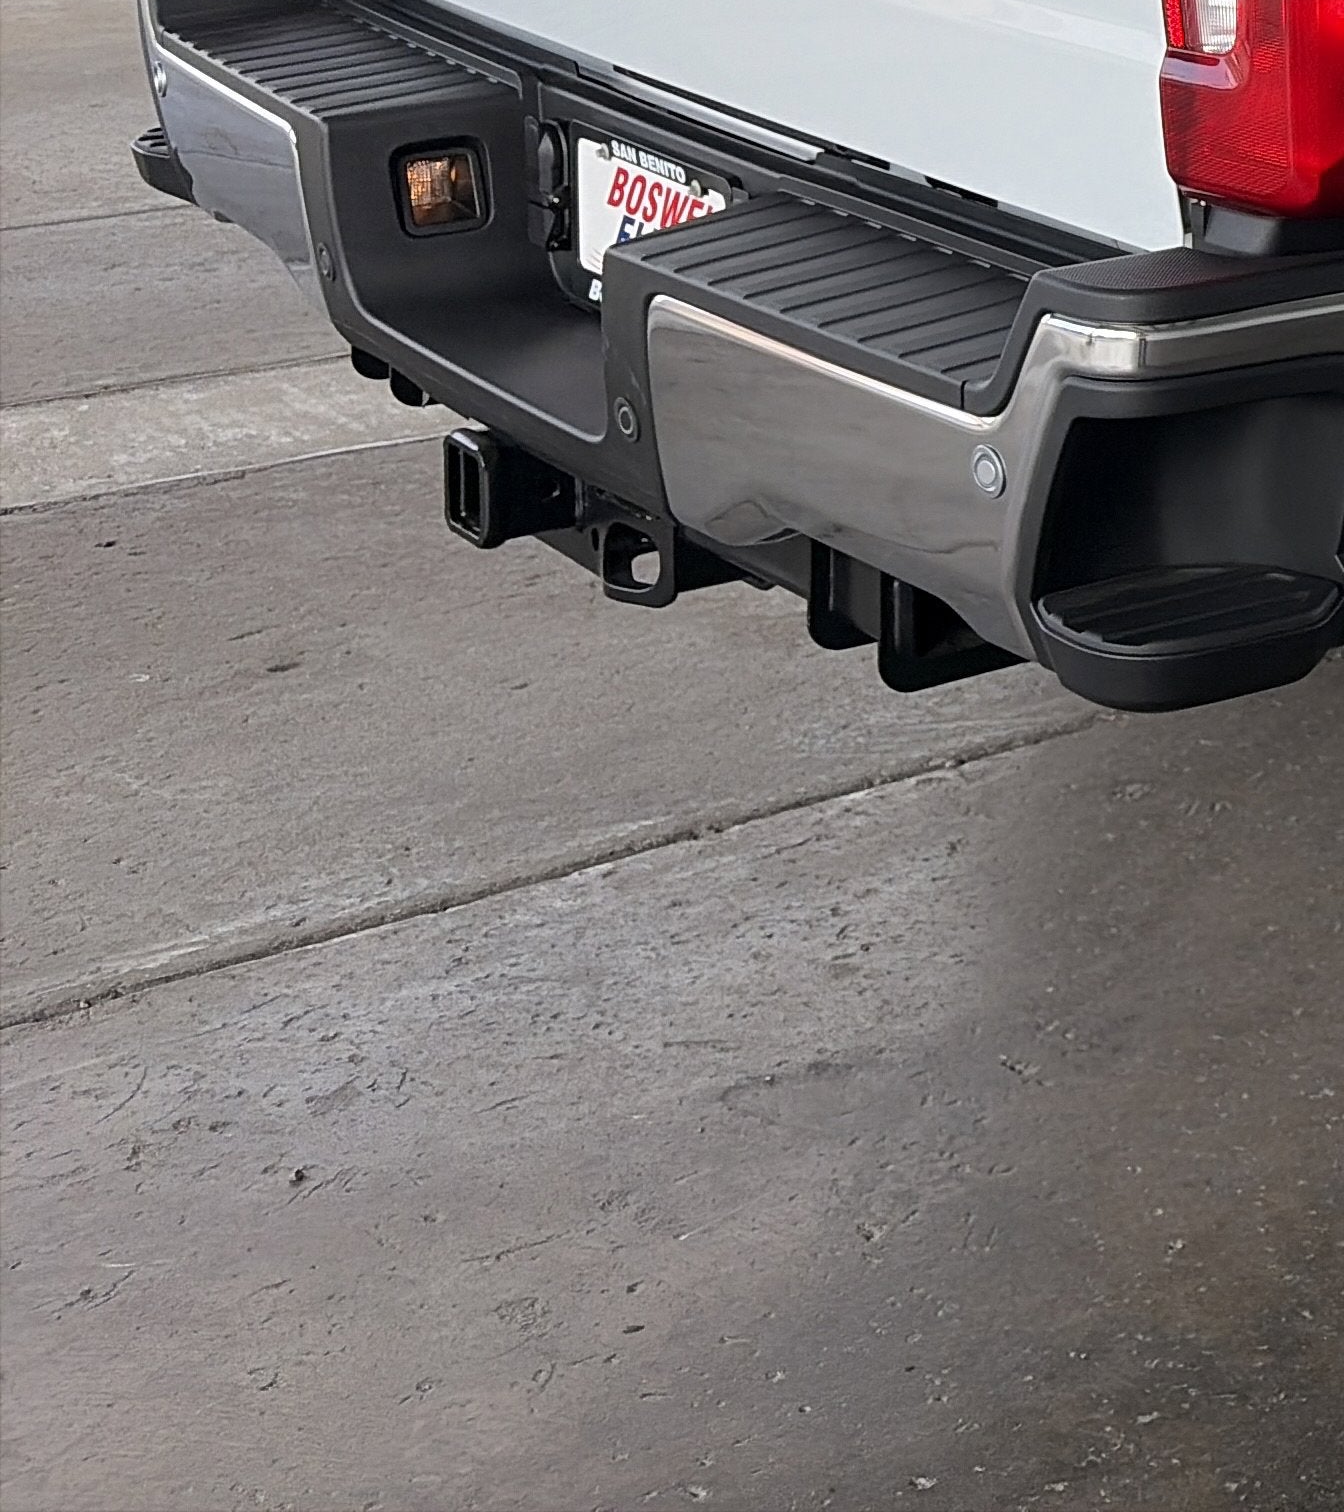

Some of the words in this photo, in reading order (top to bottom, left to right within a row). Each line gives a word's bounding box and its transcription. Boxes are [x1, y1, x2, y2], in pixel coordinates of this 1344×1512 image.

[611, 139, 637, 164] SAN
[639, 151, 686, 184] BENITO
[607, 166, 714, 229] BOSWE
